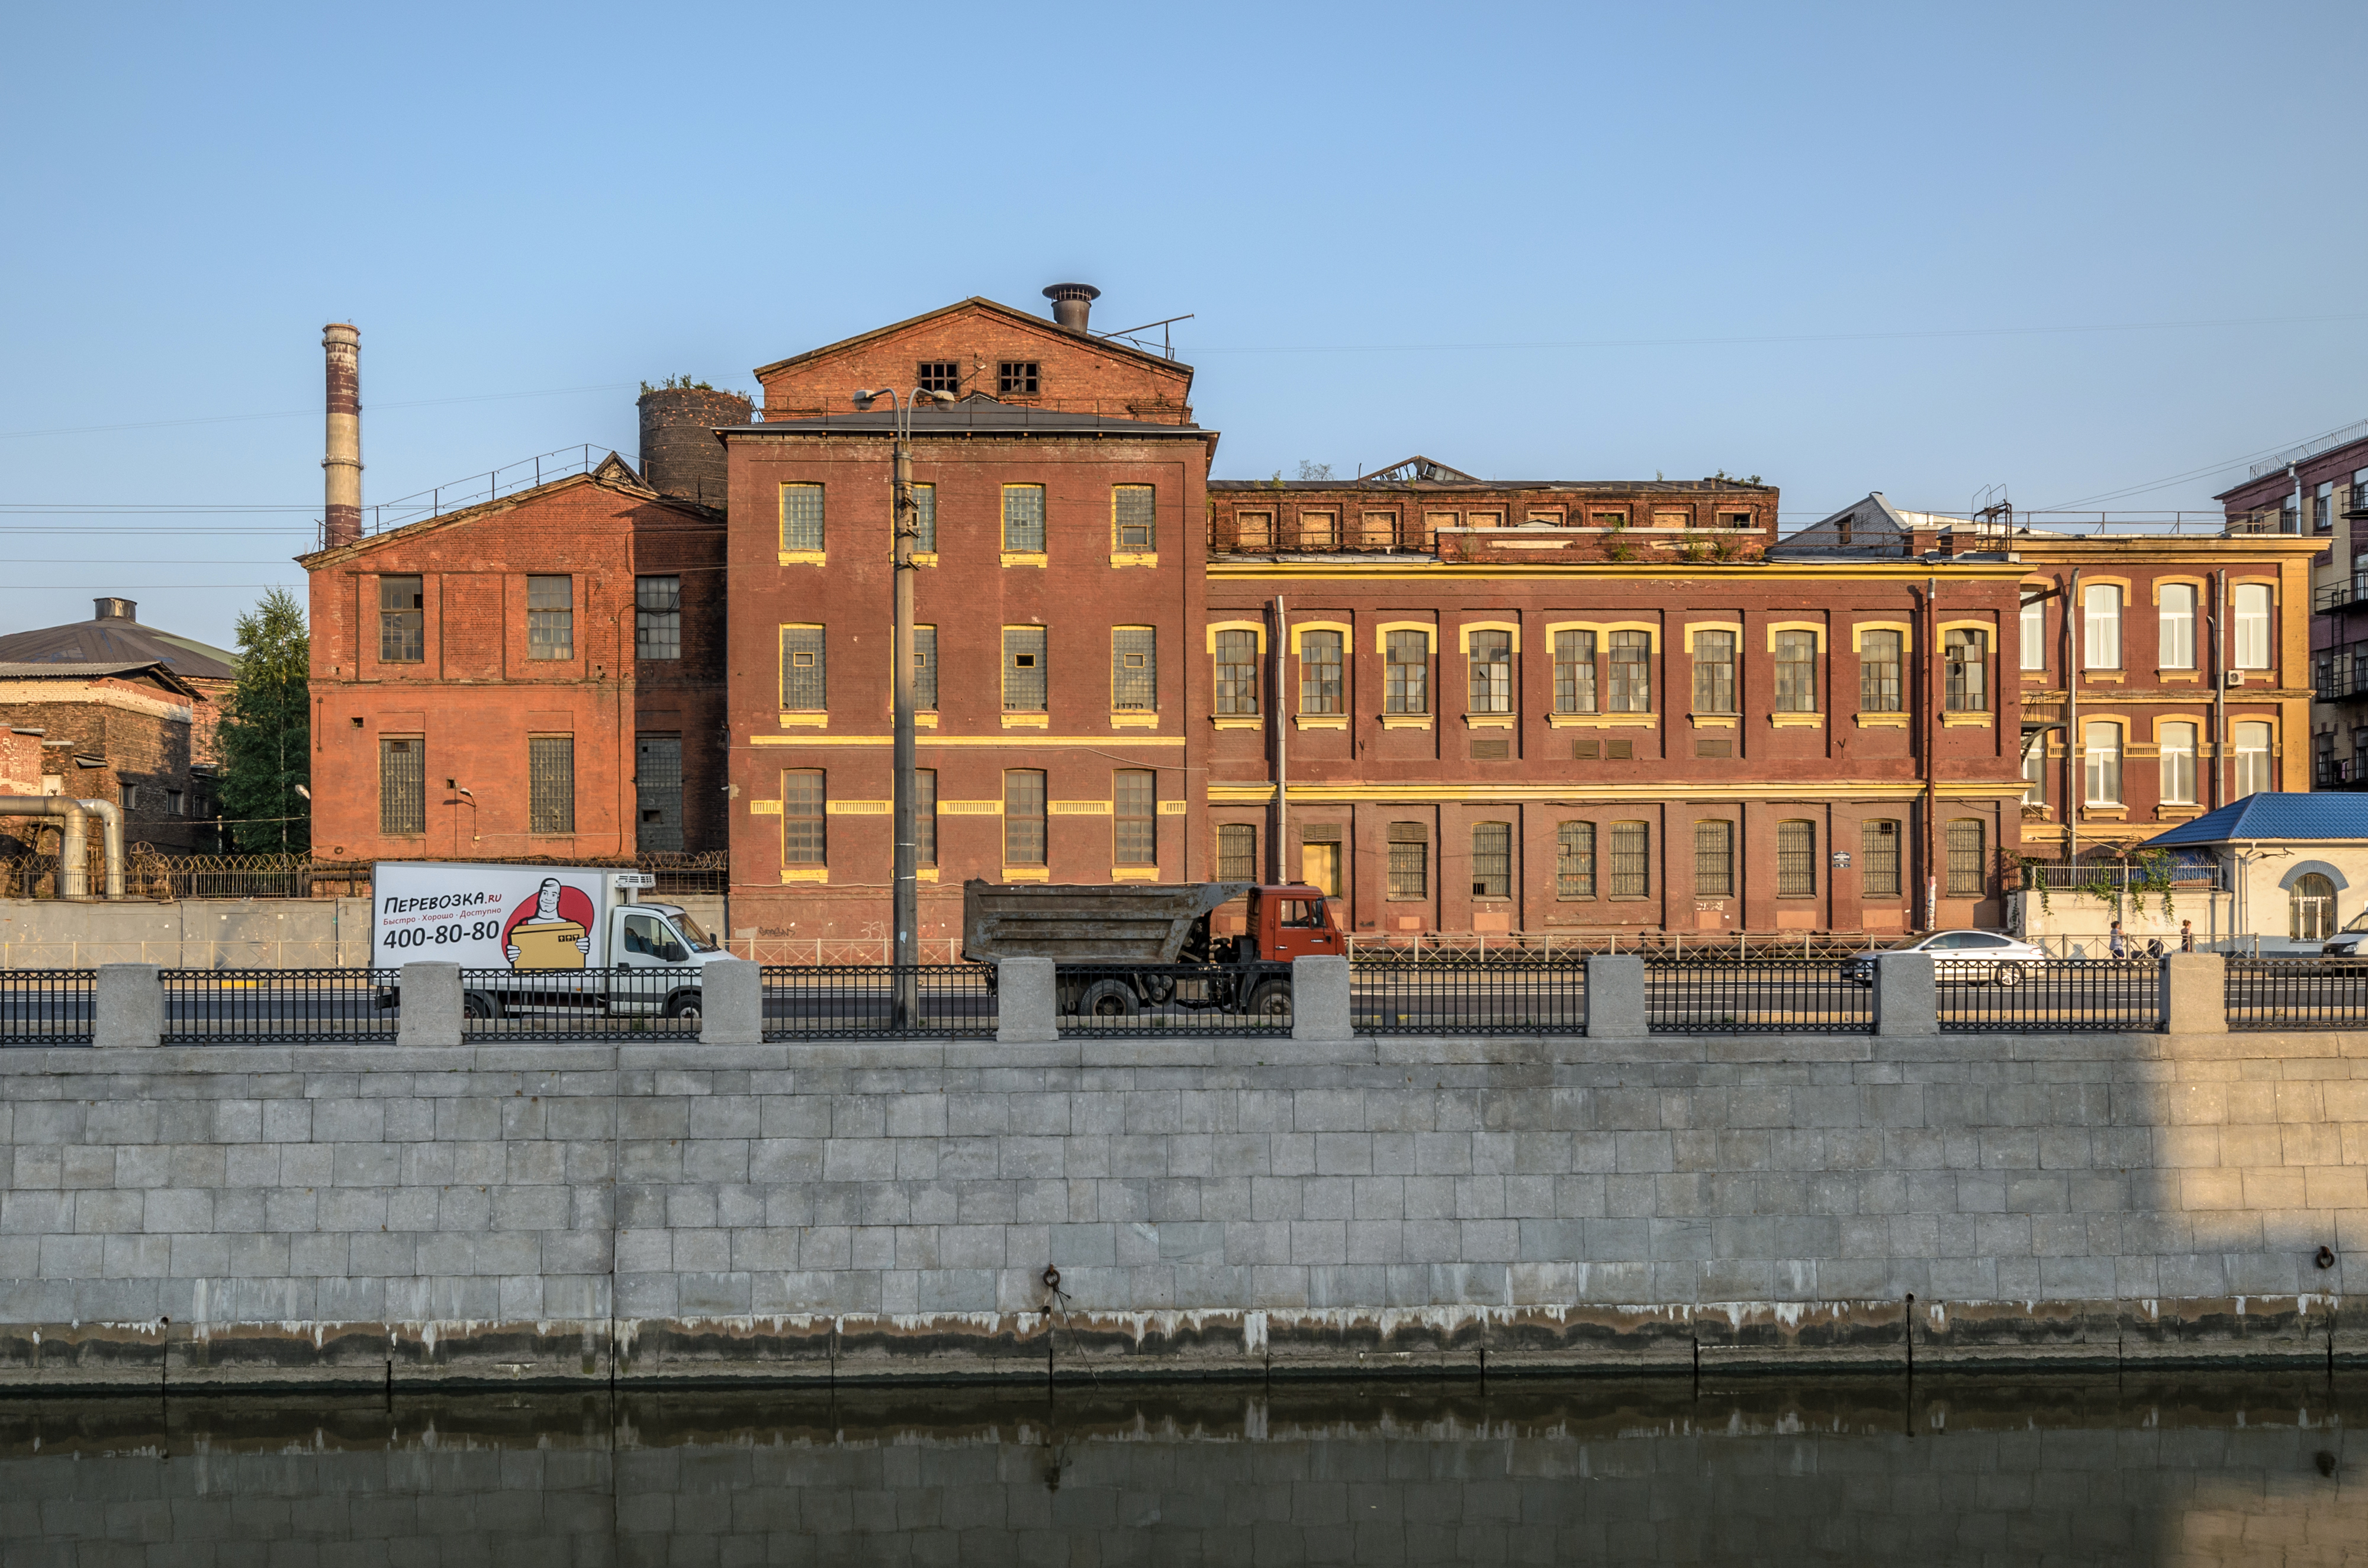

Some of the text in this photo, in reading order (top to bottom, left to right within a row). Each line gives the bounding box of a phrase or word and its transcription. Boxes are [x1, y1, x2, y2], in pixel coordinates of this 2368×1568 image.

[422, 913, 453, 922] Хорошо
[459, 908, 501, 919] Доступно
[383, 920, 500, 949] 400-80-80
